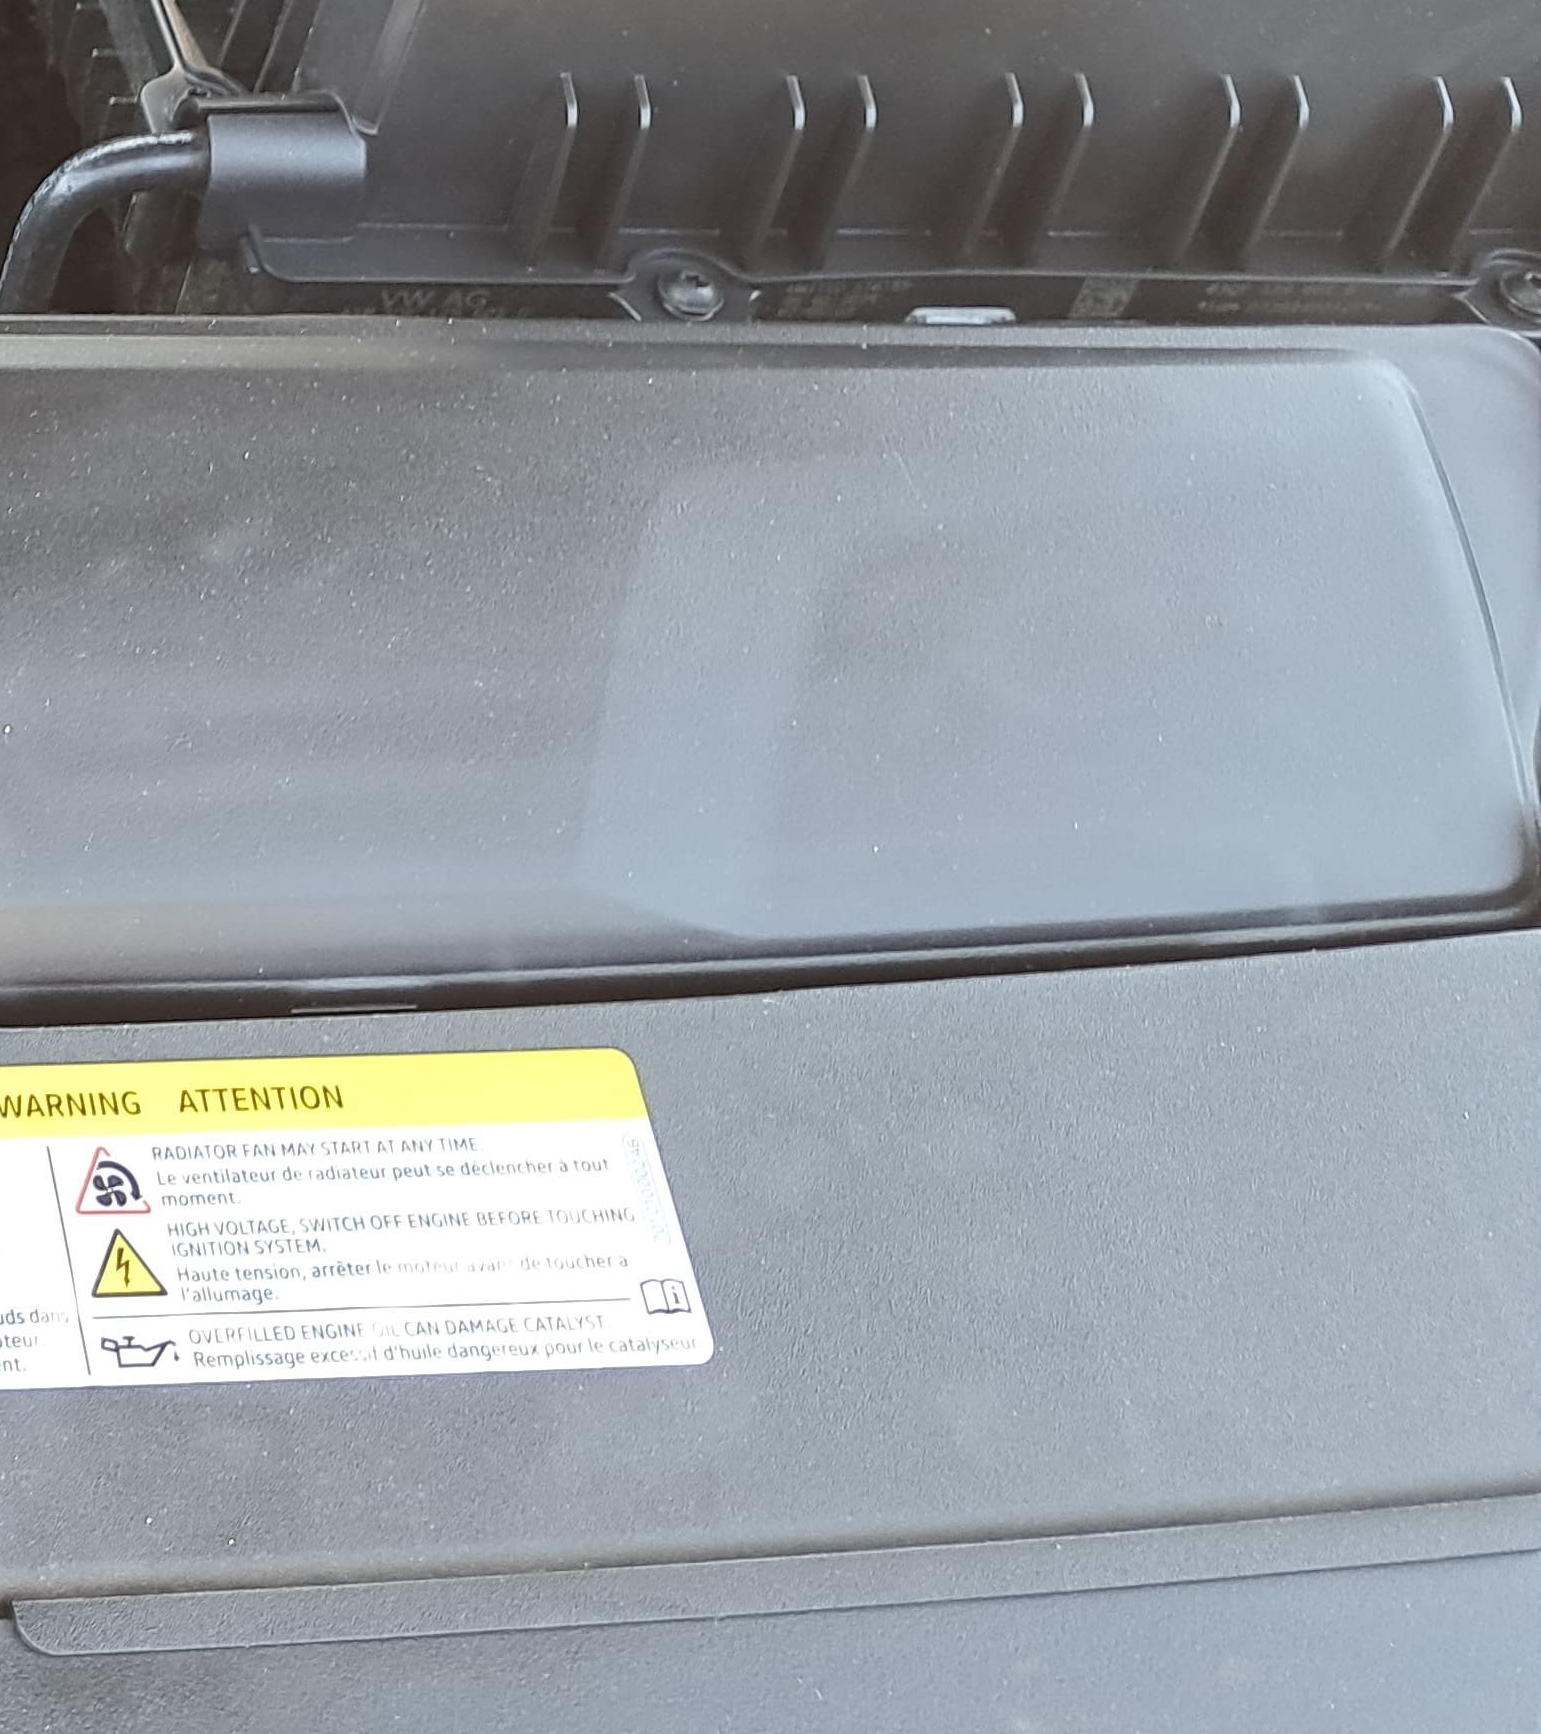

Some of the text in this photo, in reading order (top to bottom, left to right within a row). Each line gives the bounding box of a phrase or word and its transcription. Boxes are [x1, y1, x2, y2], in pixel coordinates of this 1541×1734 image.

[179, 1084, 344, 1112] ATTENTION
[152, 1139, 433, 1160] RADIATOR FAN MAY START AT ANY
[157, 1170, 177, 1186] Le
[182, 1168, 277, 1185] ventilateur
[282, 1166, 302, 1181] de
[309, 1164, 387, 1181] radiateur
[393, 1165, 431, 1181] peut
[437, 1165, 455, 1177] se
[461, 1161, 553, 1177] déclencher
[574, 1159, 608, 1172] tout
[161, 1191, 241, 1207] moment.
[168, 1208, 636, 1238] HIGH VOLTAGE, SWITCH OFF ENGINE BEFORE TOUCHING
[173, 1238, 327, 1257] IGNITION SYSTEM.
[177, 1267, 230, 1283] Haute
[236, 1265, 306, 1282] tension,
[189, 1318, 518, 1344] OVERFILLED ENGINE CAN DAMAGE
[193, 1338, 603, 1370] Remplissage d'huile dangereux pour le
